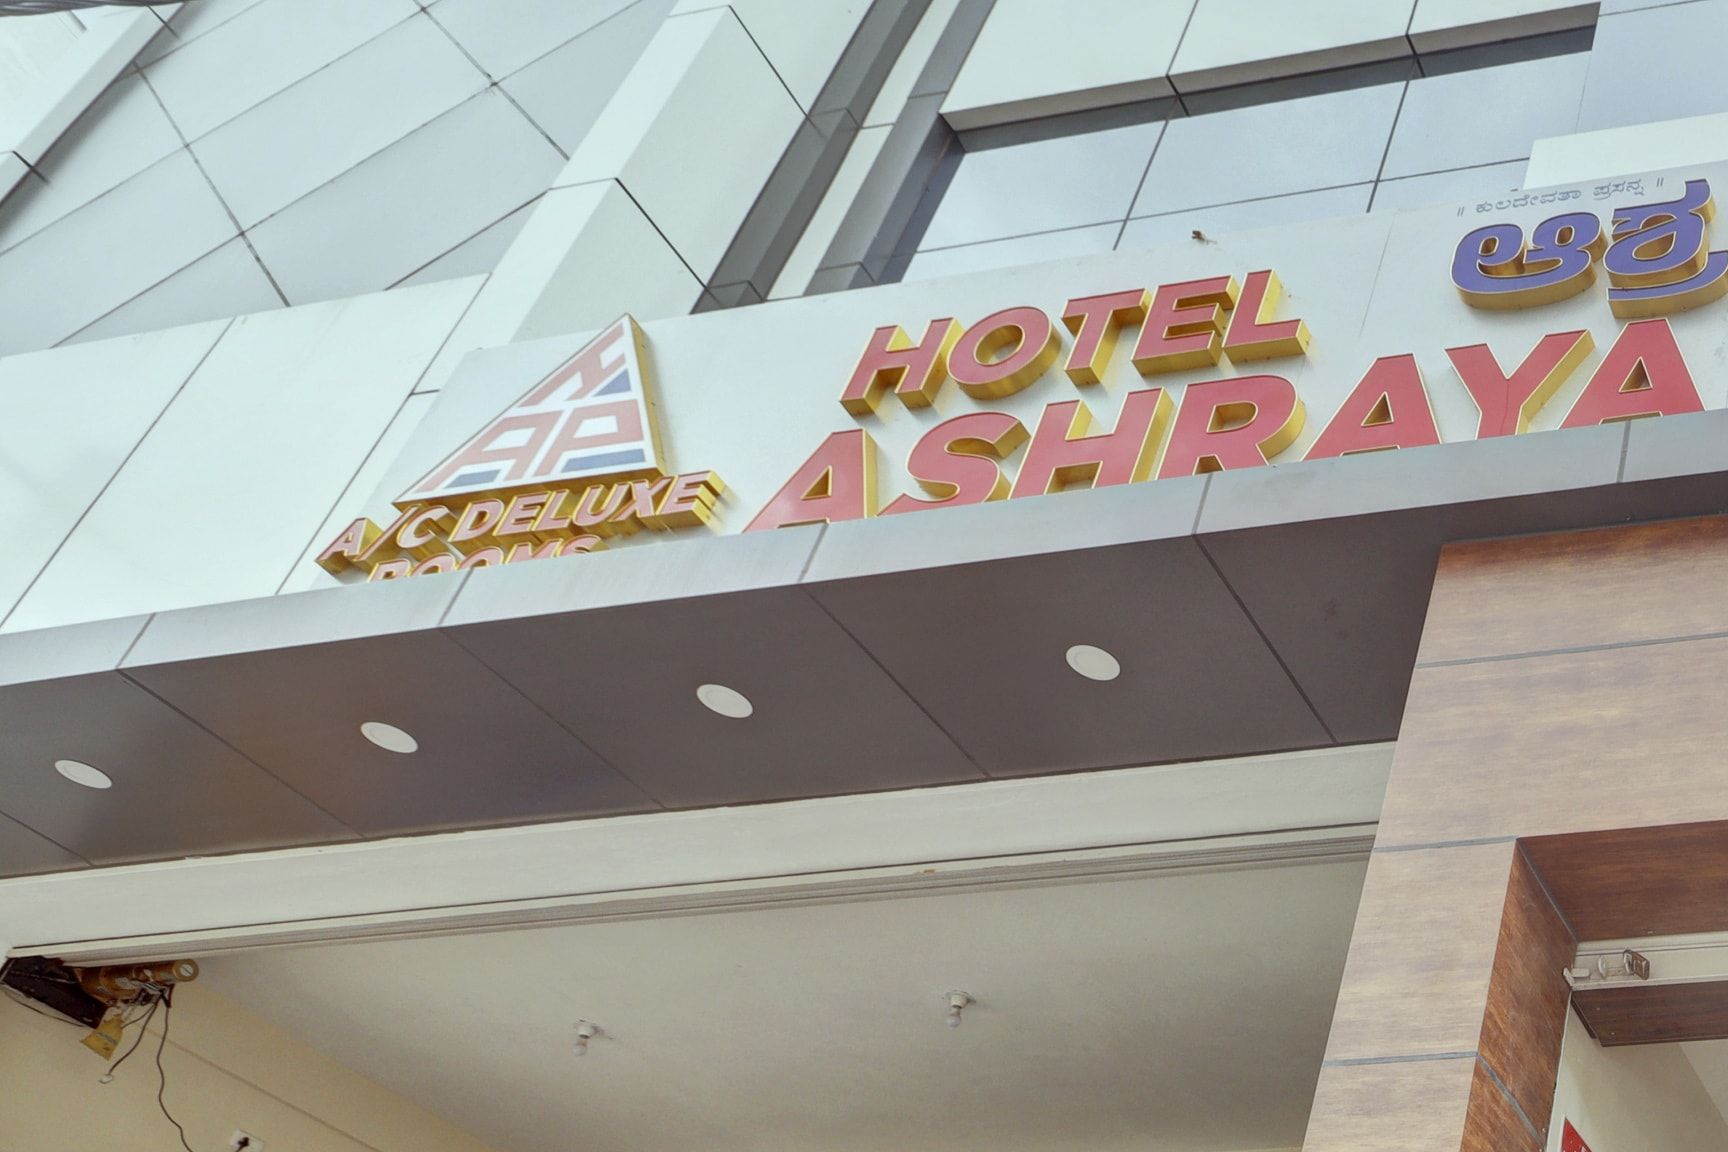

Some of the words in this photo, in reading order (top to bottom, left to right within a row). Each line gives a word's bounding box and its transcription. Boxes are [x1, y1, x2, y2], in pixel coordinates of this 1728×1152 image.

[839, 269, 1308, 414] HOTEL
[742, 318, 1708, 534] ASHRAYA
[448, 470, 722, 548] DELUXE
